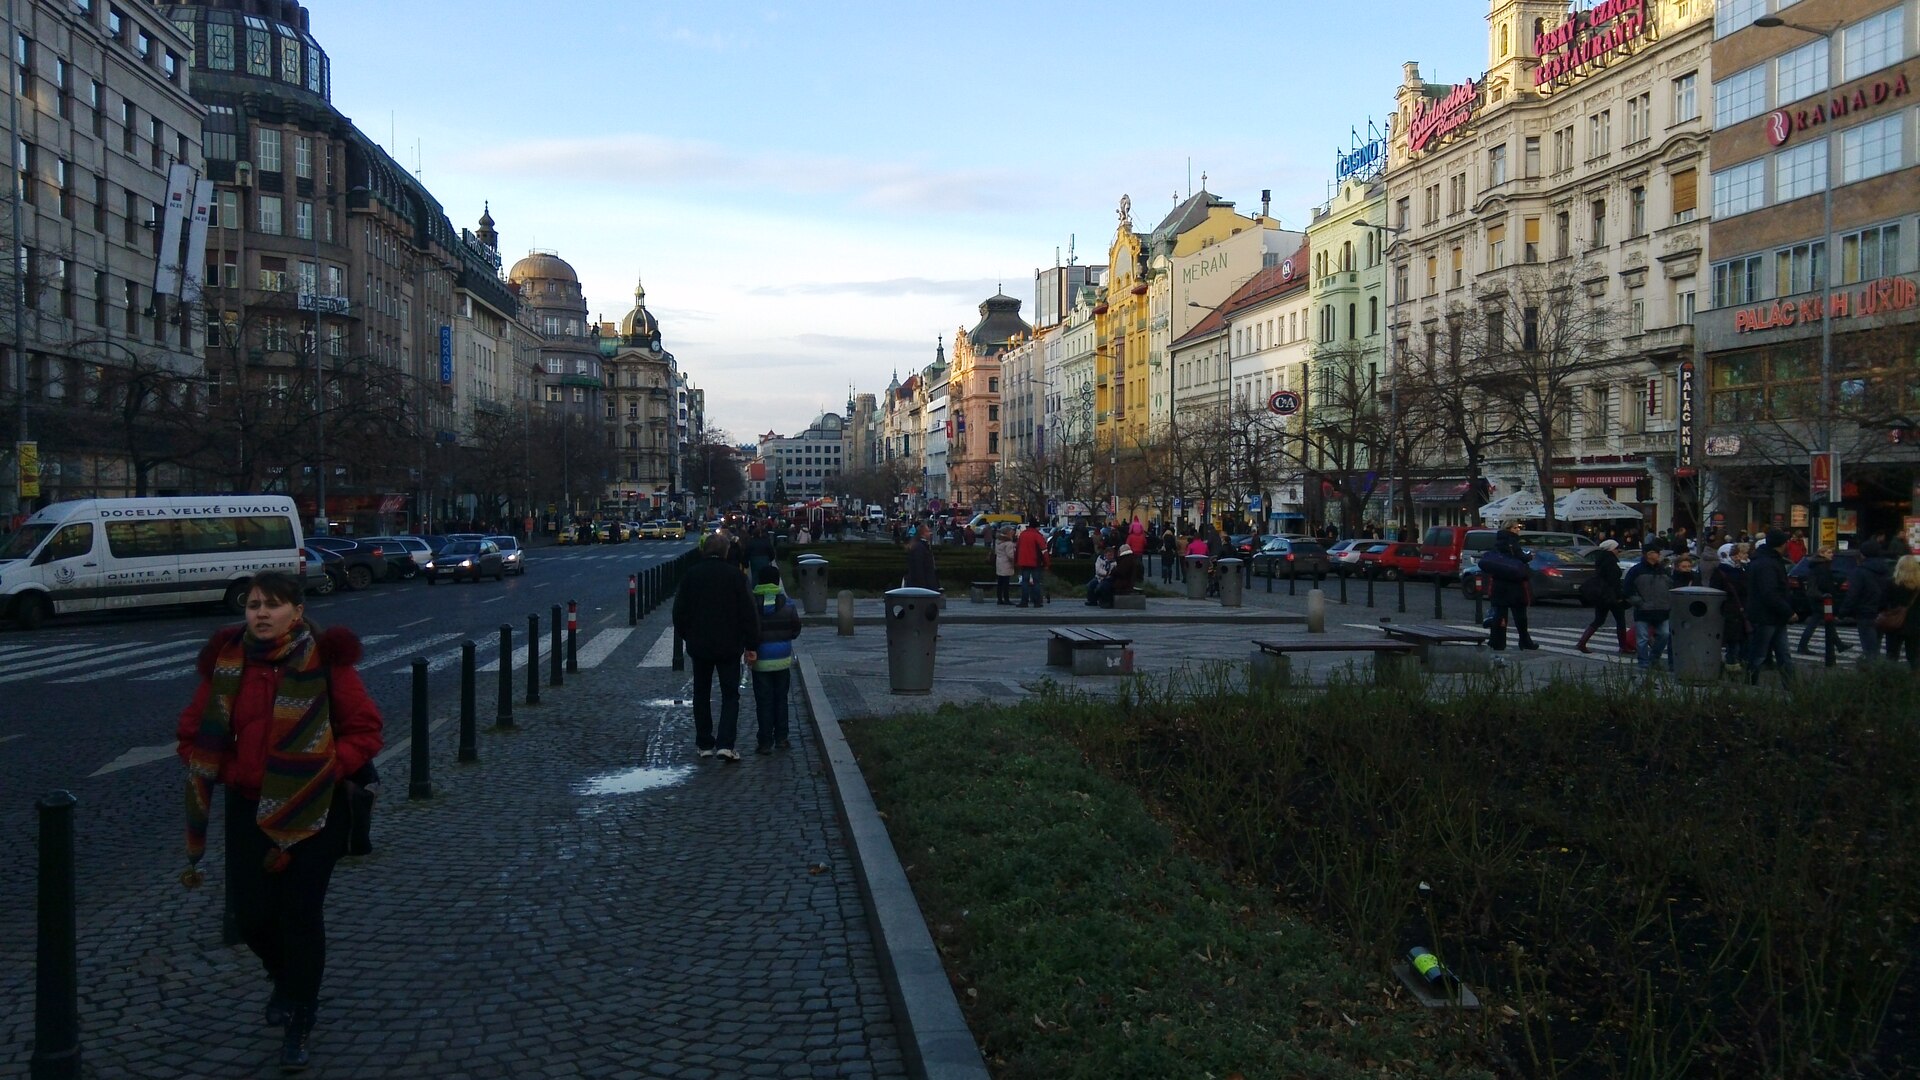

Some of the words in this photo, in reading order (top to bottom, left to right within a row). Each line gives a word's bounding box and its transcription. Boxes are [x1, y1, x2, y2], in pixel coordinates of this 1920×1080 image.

[1535, 11, 1577, 57] ČESKÝ
[1796, 74, 1910, 133] RAMADA
[1340, 142, 1379, 177] CASINO
[1183, 252, 1228, 284] MERAN
[1735, 299, 1795, 333] PALÁC
[1856, 276, 1917, 317] LUXOR
[442, 329, 450, 381] ROKOKO
[1275, 397, 1295, 408] C&A
[1682, 426, 1690, 465] KNIH
[101, 509, 166, 518] DOCELA
[172, 505, 221, 515] VELKÉ
[228, 505, 290, 514] DIVADLO
[108, 570, 155, 580] QUITE
[178, 566, 225, 574] GREAT
[233, 562, 296, 570] THEATRE
